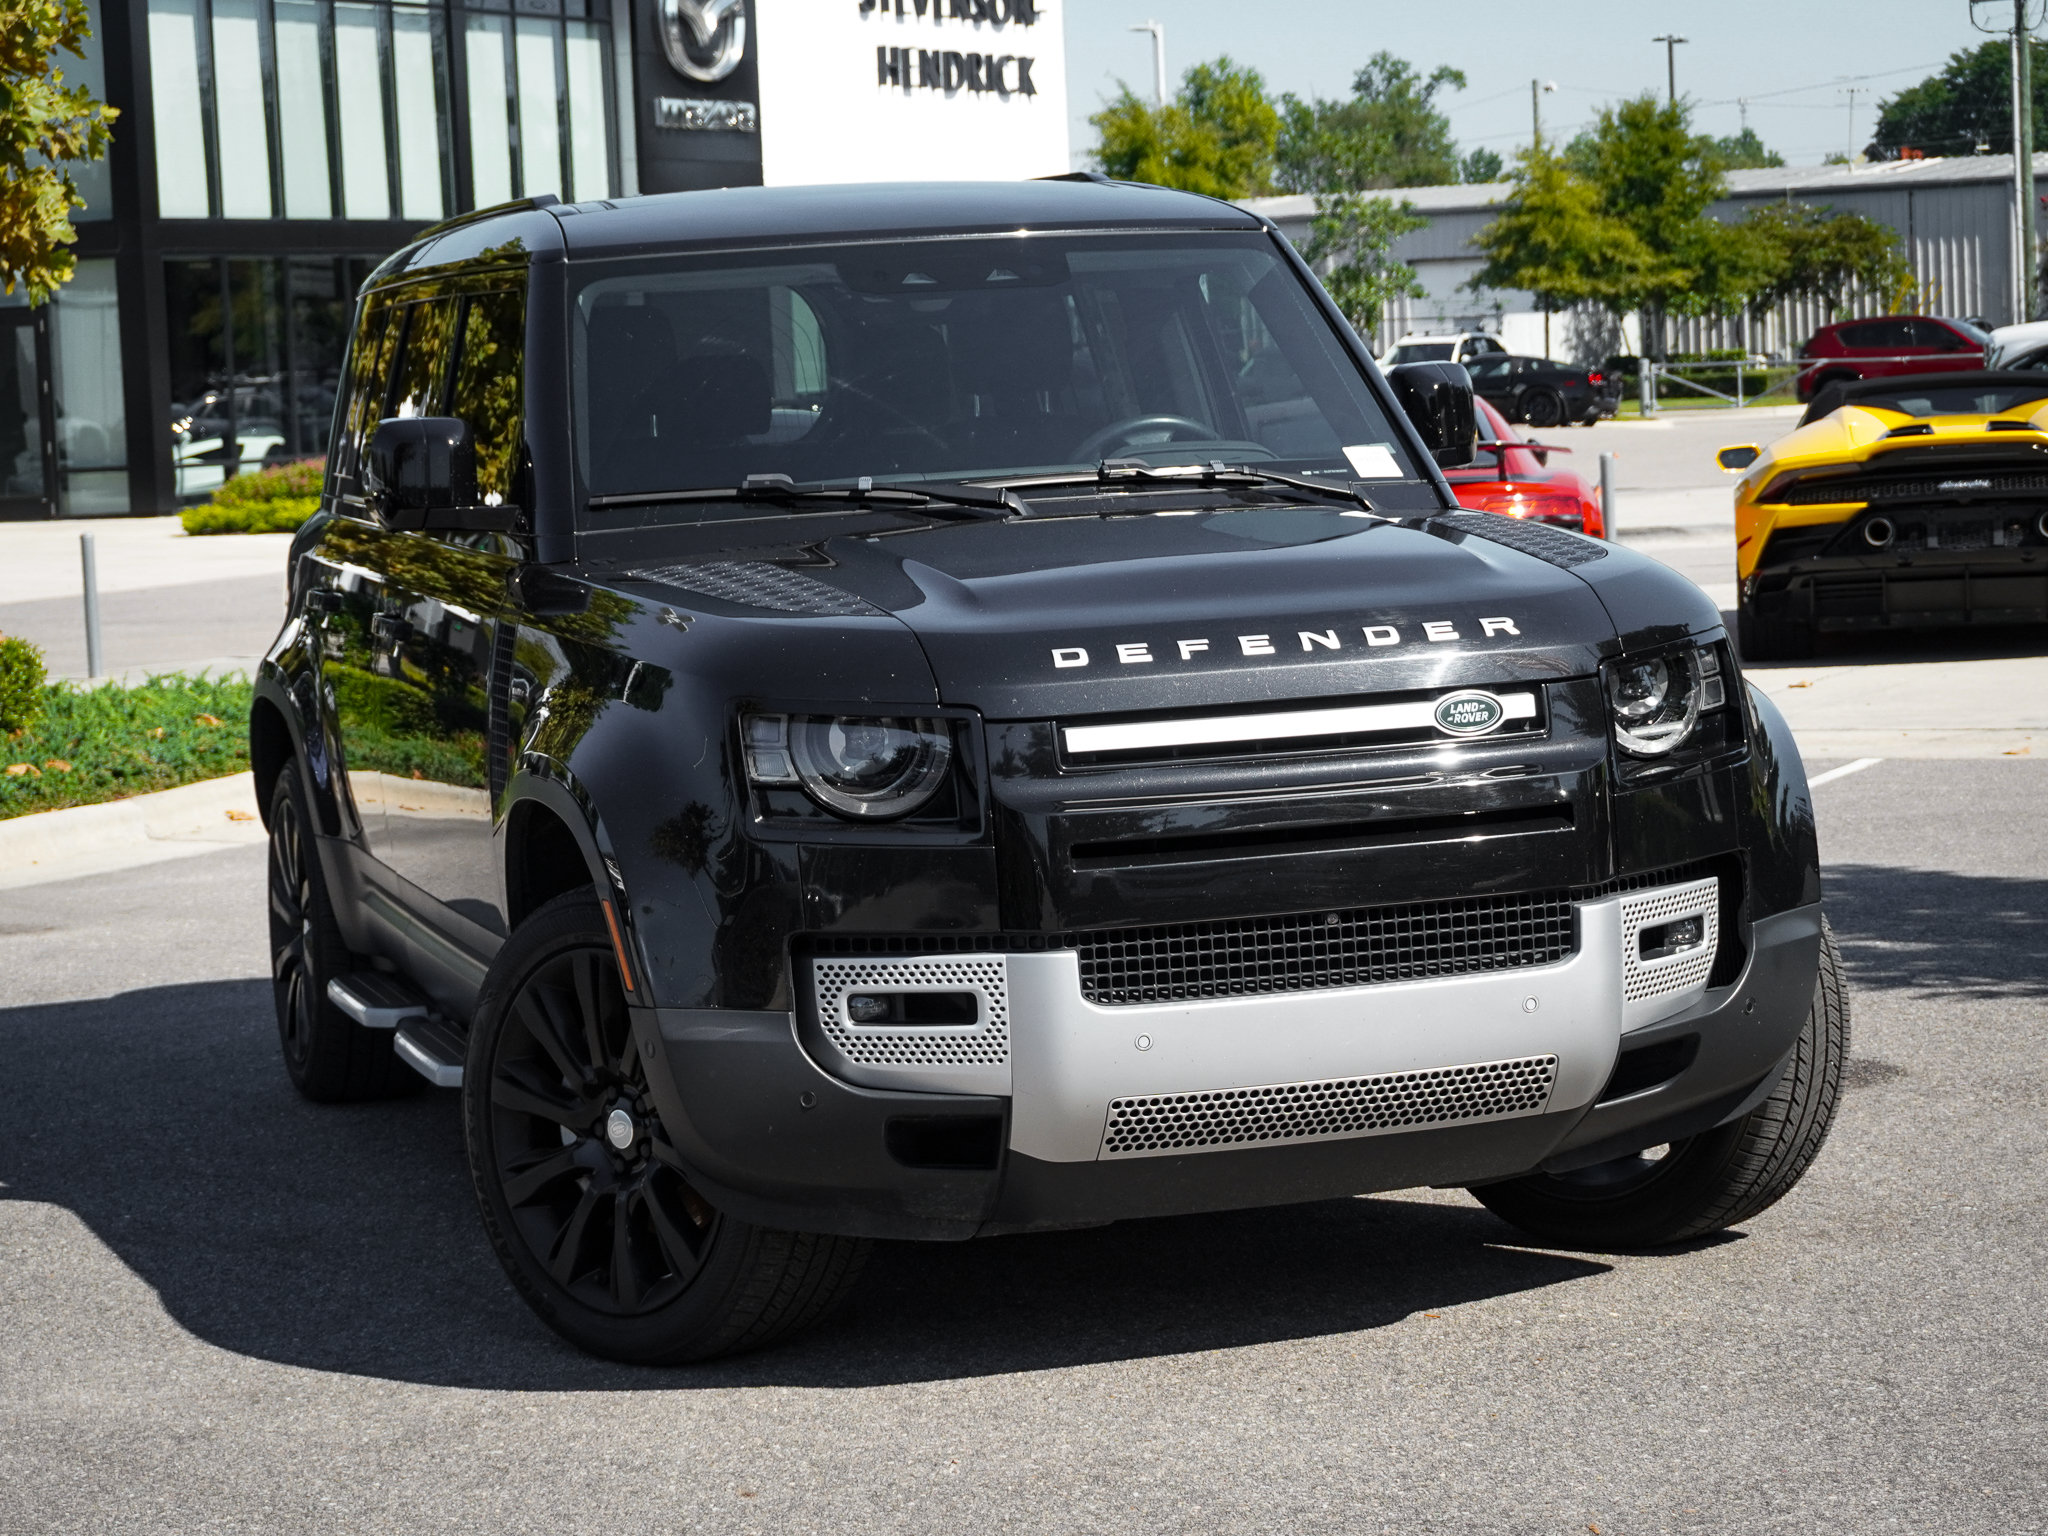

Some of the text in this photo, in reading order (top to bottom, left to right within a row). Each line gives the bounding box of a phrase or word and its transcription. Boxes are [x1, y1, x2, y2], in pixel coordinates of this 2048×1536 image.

[876, 46, 1038, 97] HENDRICK
[1051, 616, 1521, 669] DEFENDER
[1450, 702, 1479, 714] LAND
[1453, 711, 1489, 724] ROVER
